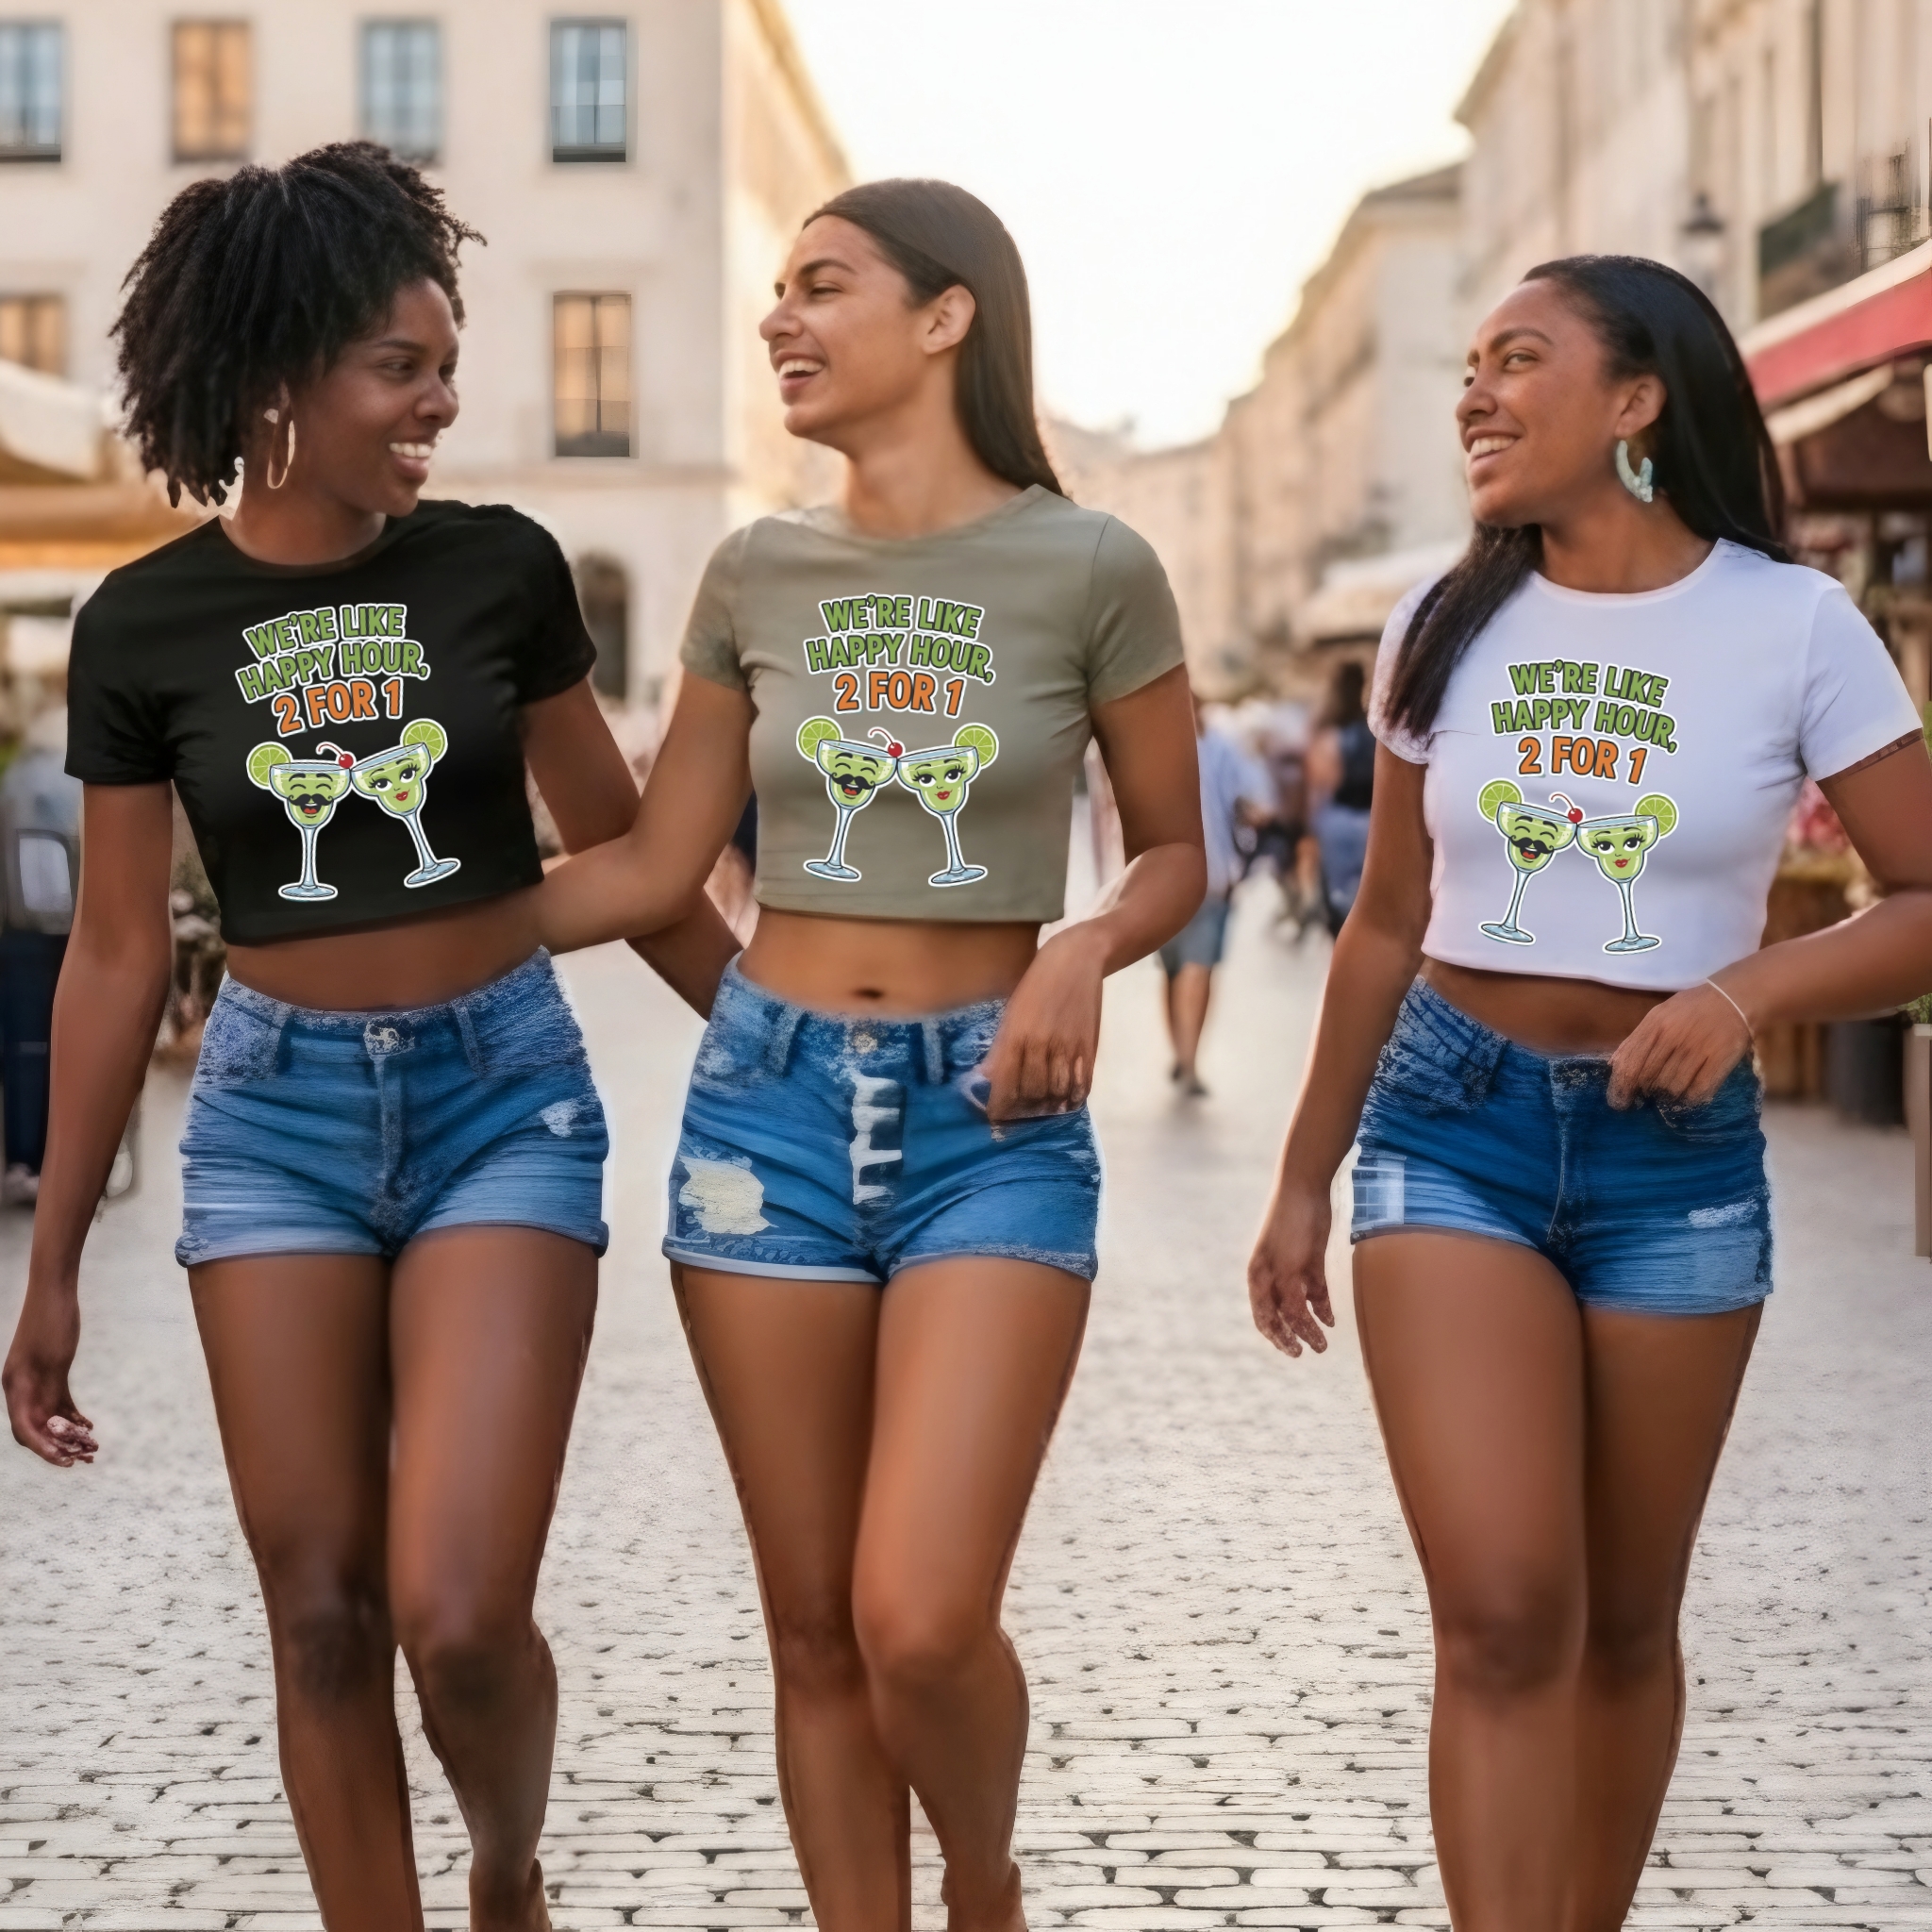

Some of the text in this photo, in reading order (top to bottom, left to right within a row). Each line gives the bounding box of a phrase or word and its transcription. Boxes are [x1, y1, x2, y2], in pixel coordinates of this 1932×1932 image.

[245, 606, 406, 658] WE'RE LIKE
[821, 594, 982, 639] WE'RE LIKE
[237, 641, 429, 701] HAPPY HOUR,
[806, 633, 993, 683] HAPPY HOUR,
[274, 678, 401, 734] 2 FOR 1
[835, 671, 964, 716] 2 FOR 1
[1508, 659, 1669, 708] WE'RE LIKE
[1491, 698, 1677, 754] HAPPY HOUR,
[1518, 736, 1647, 784] 2 FOR 1
